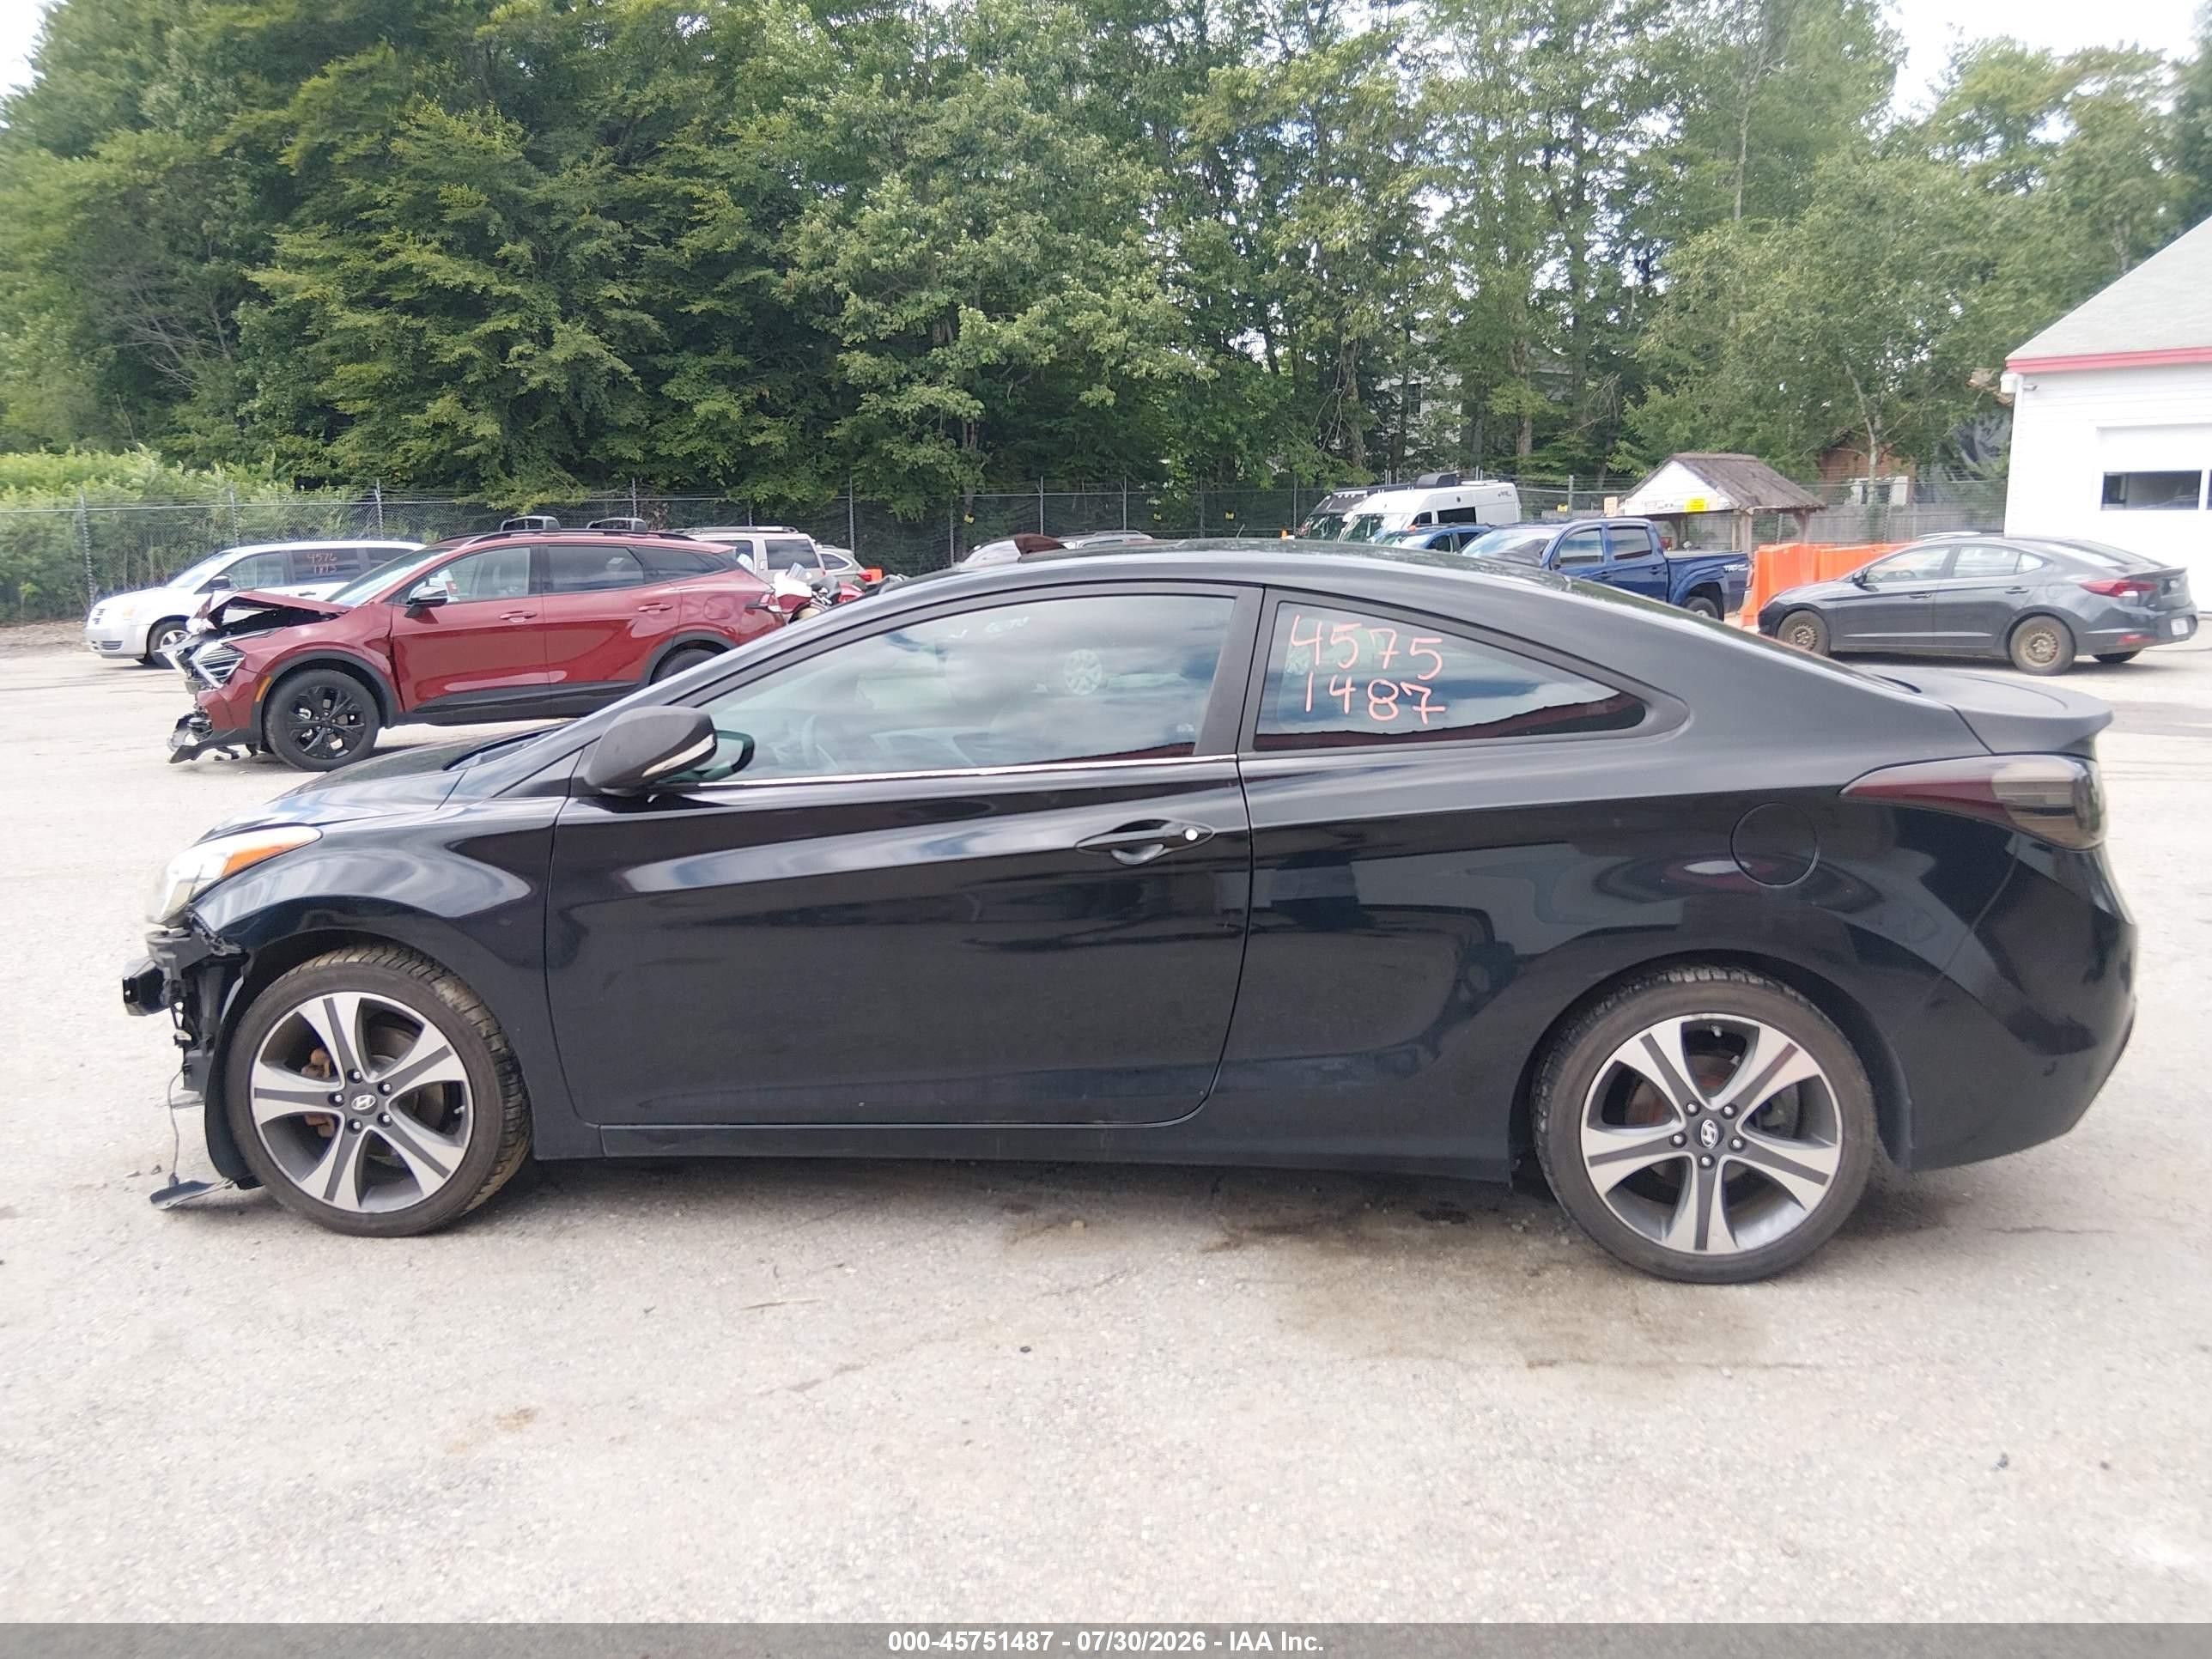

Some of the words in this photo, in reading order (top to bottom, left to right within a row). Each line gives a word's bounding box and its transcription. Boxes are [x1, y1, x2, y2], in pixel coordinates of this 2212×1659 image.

[307, 552, 337, 565] 4576
[1290, 615, 1444, 681] 4575
[1305, 672, 1446, 725] 1487
